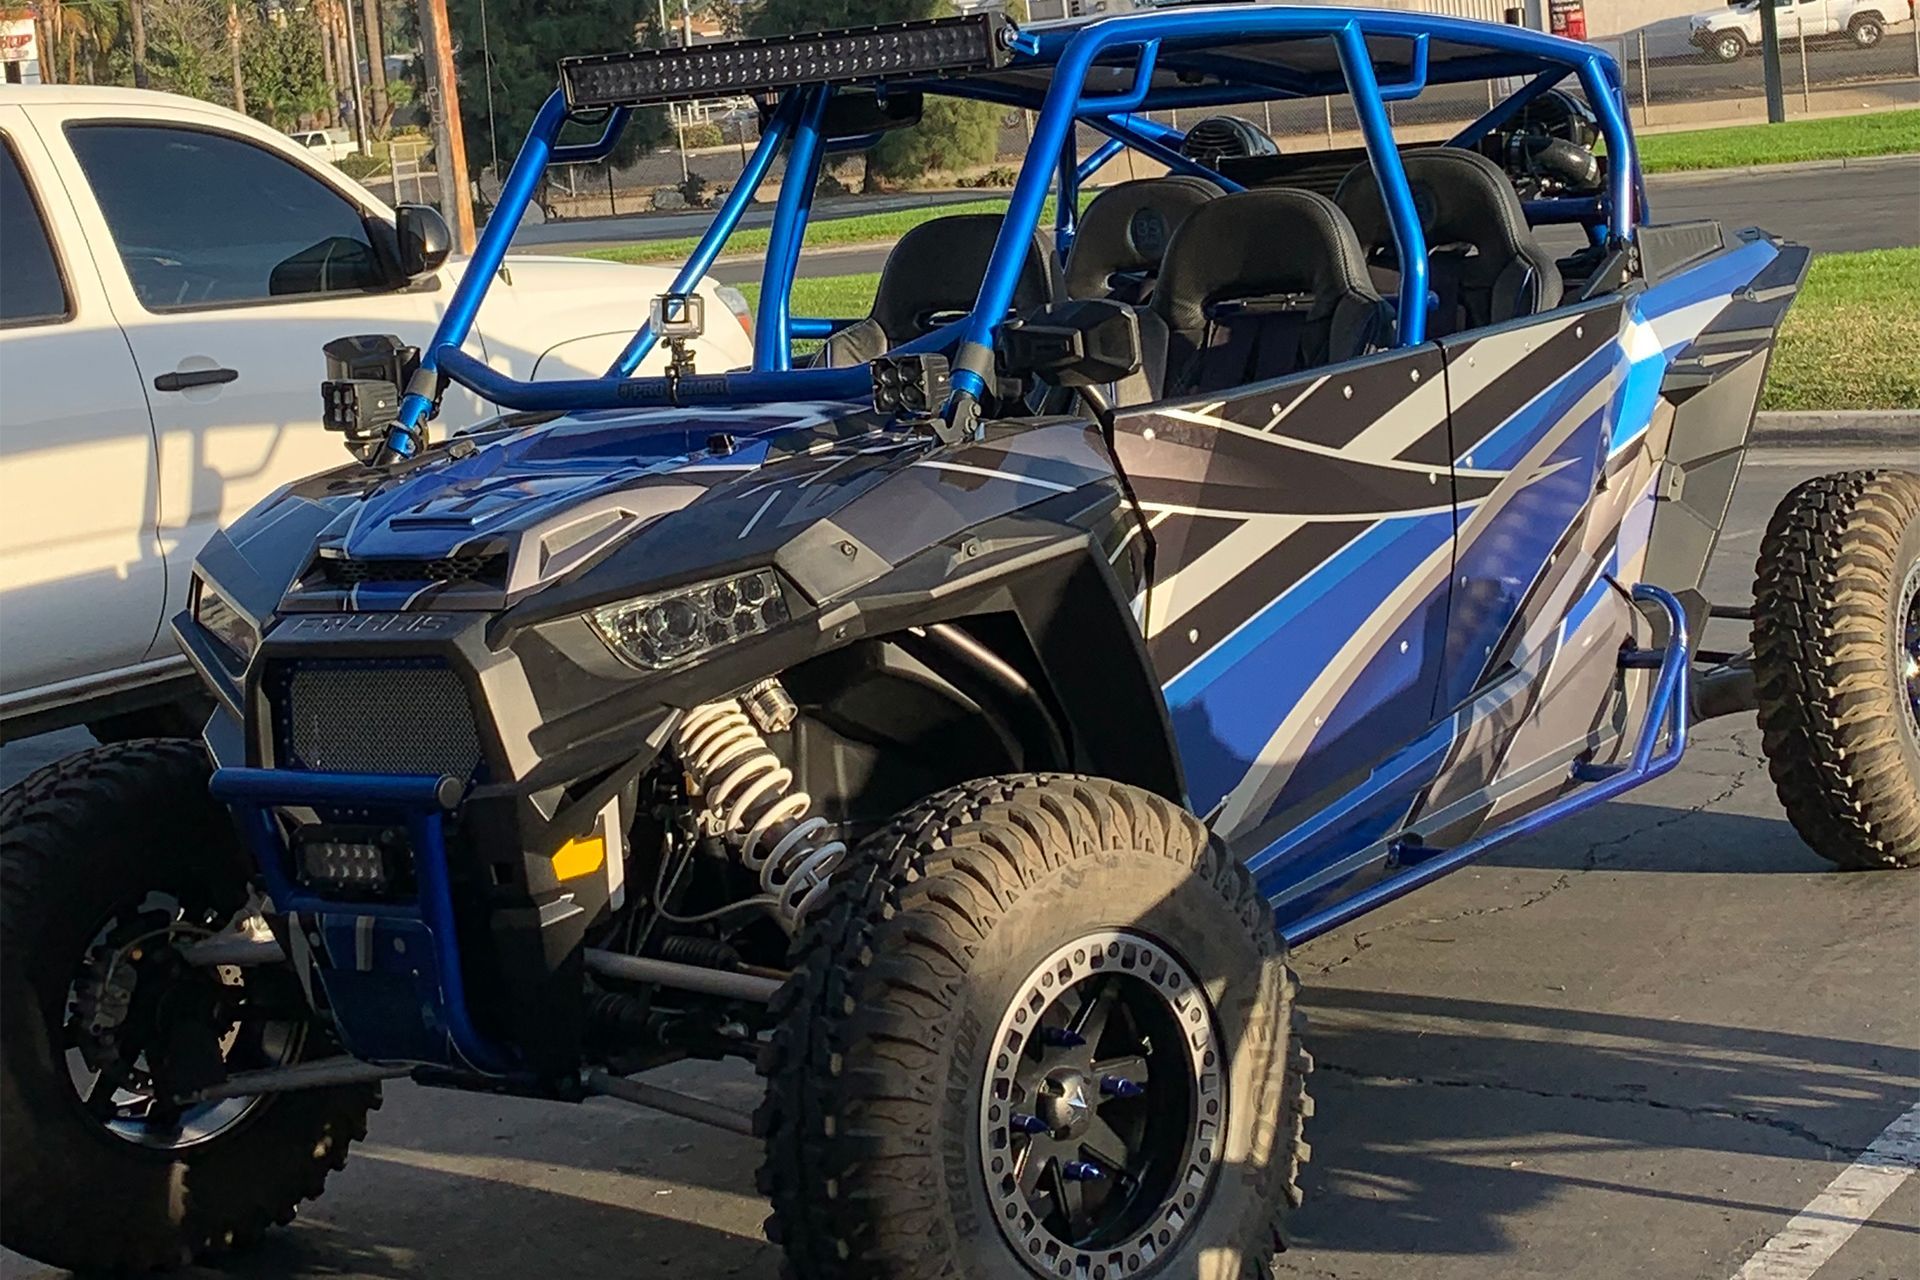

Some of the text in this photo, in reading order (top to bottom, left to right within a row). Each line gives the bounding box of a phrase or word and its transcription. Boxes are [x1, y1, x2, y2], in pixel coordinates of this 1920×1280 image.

[633, 380, 725, 397] PRO RMOR
[291, 614, 449, 633] POLARIS
